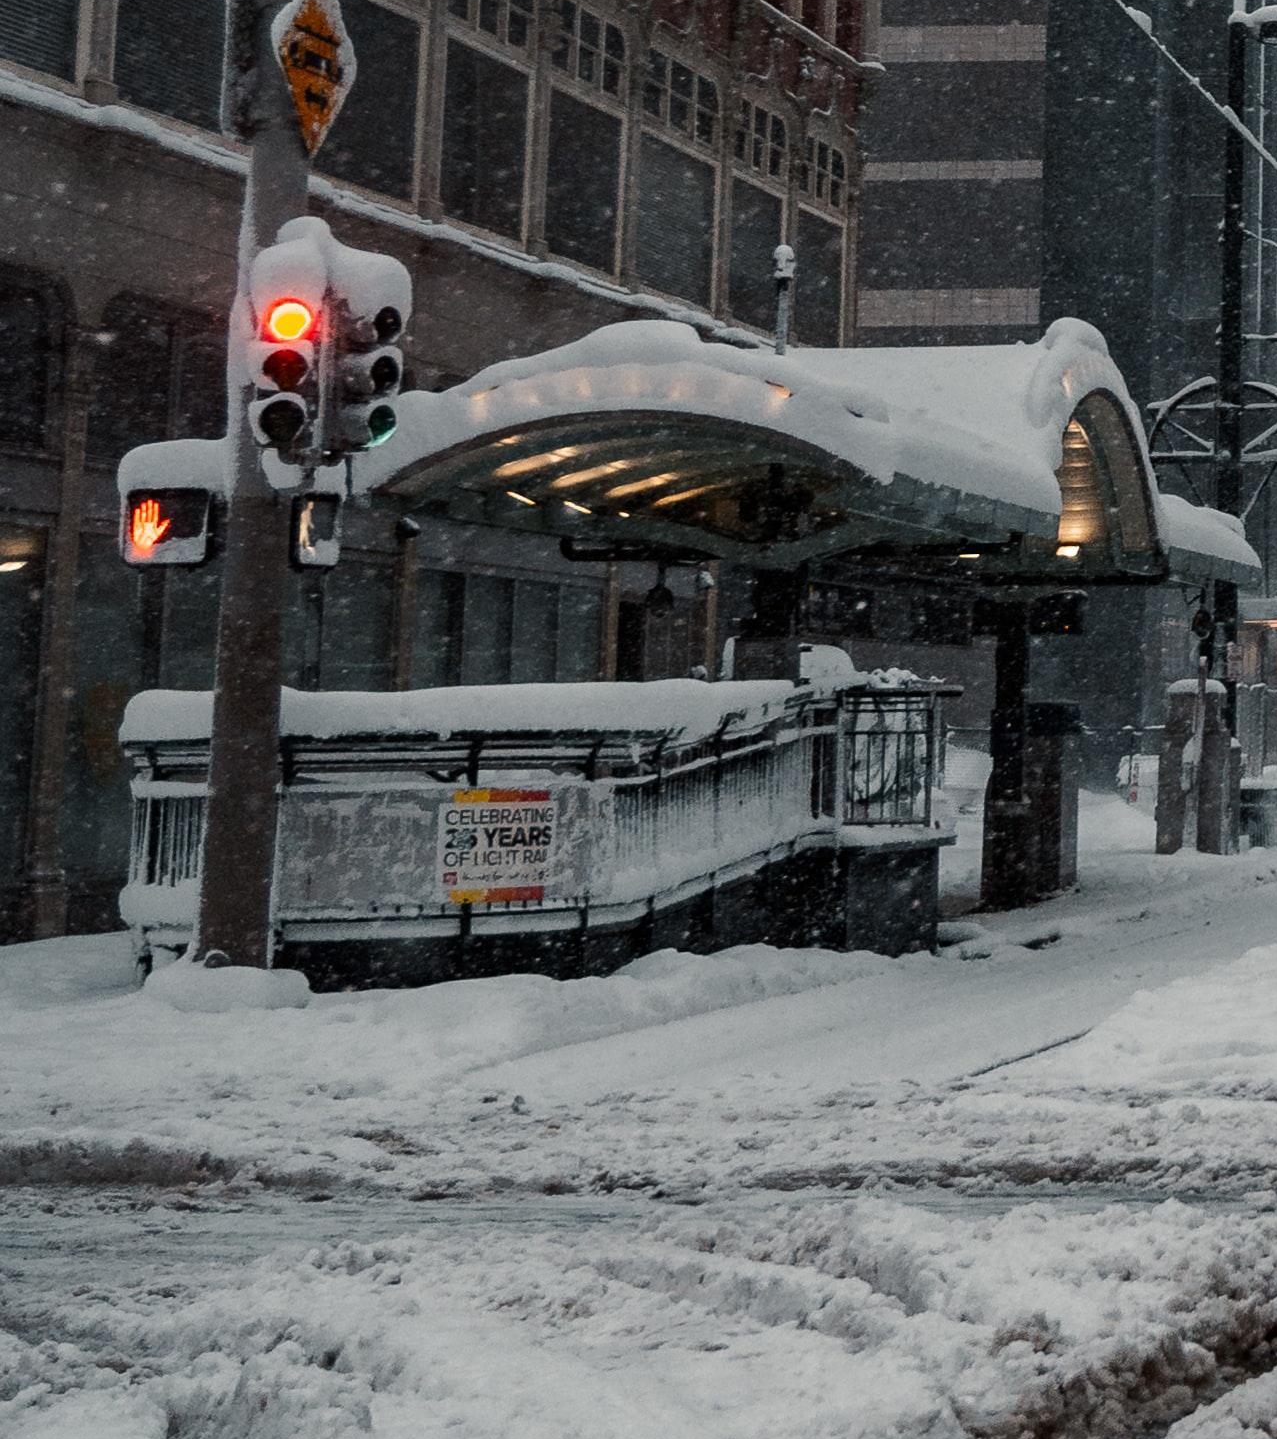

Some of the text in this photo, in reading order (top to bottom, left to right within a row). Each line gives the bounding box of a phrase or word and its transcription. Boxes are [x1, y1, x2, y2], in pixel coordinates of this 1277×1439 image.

[445, 807, 554, 825] CELEBRATING
[483, 825, 552, 848] YEARS
[444, 851, 471, 867] OF
